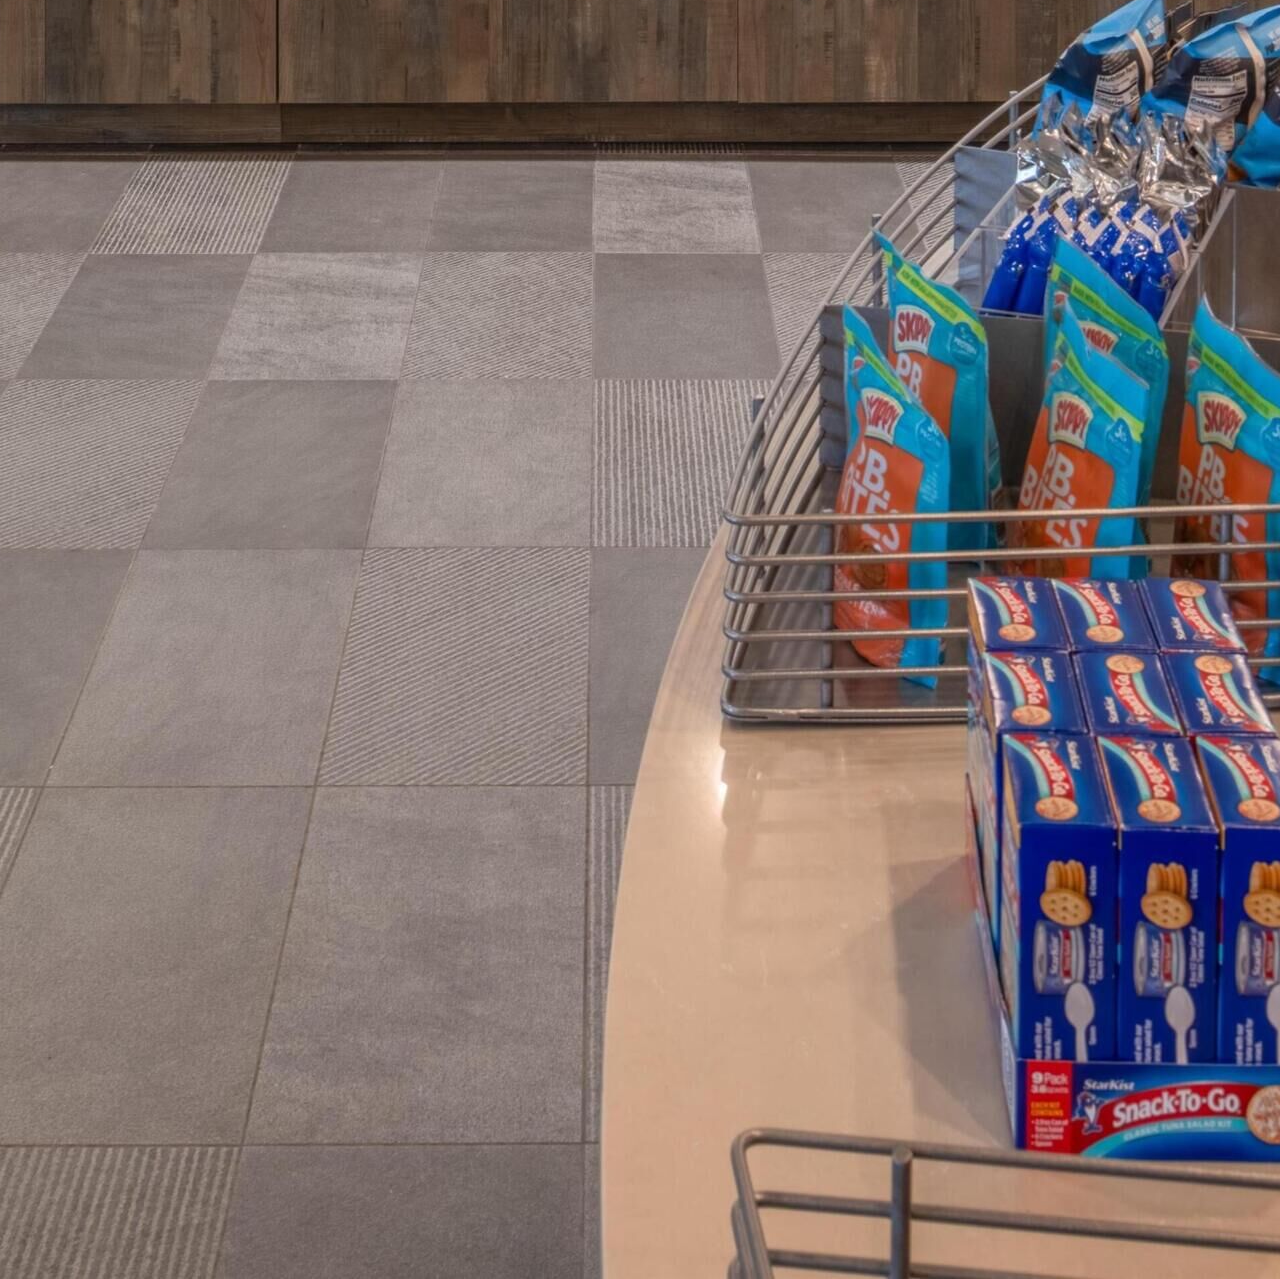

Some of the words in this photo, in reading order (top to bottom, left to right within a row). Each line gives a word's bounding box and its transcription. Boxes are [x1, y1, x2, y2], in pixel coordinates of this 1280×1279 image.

[1056, 400, 1090, 439] SKIPPY
[1203, 399, 1244, 444] SKIPPY
[1031, 1072, 1042, 1084] 9
[1044, 1072, 1068, 1085] Pack
[1083, 1078, 1135, 1091] StarKist
[1123, 1125, 1159, 1141] CLASSIC
[1161, 1122, 1185, 1134] TUNA
[1186, 1121, 1216, 1131] SALAD
[1217, 1120, 1232, 1129] KIT
